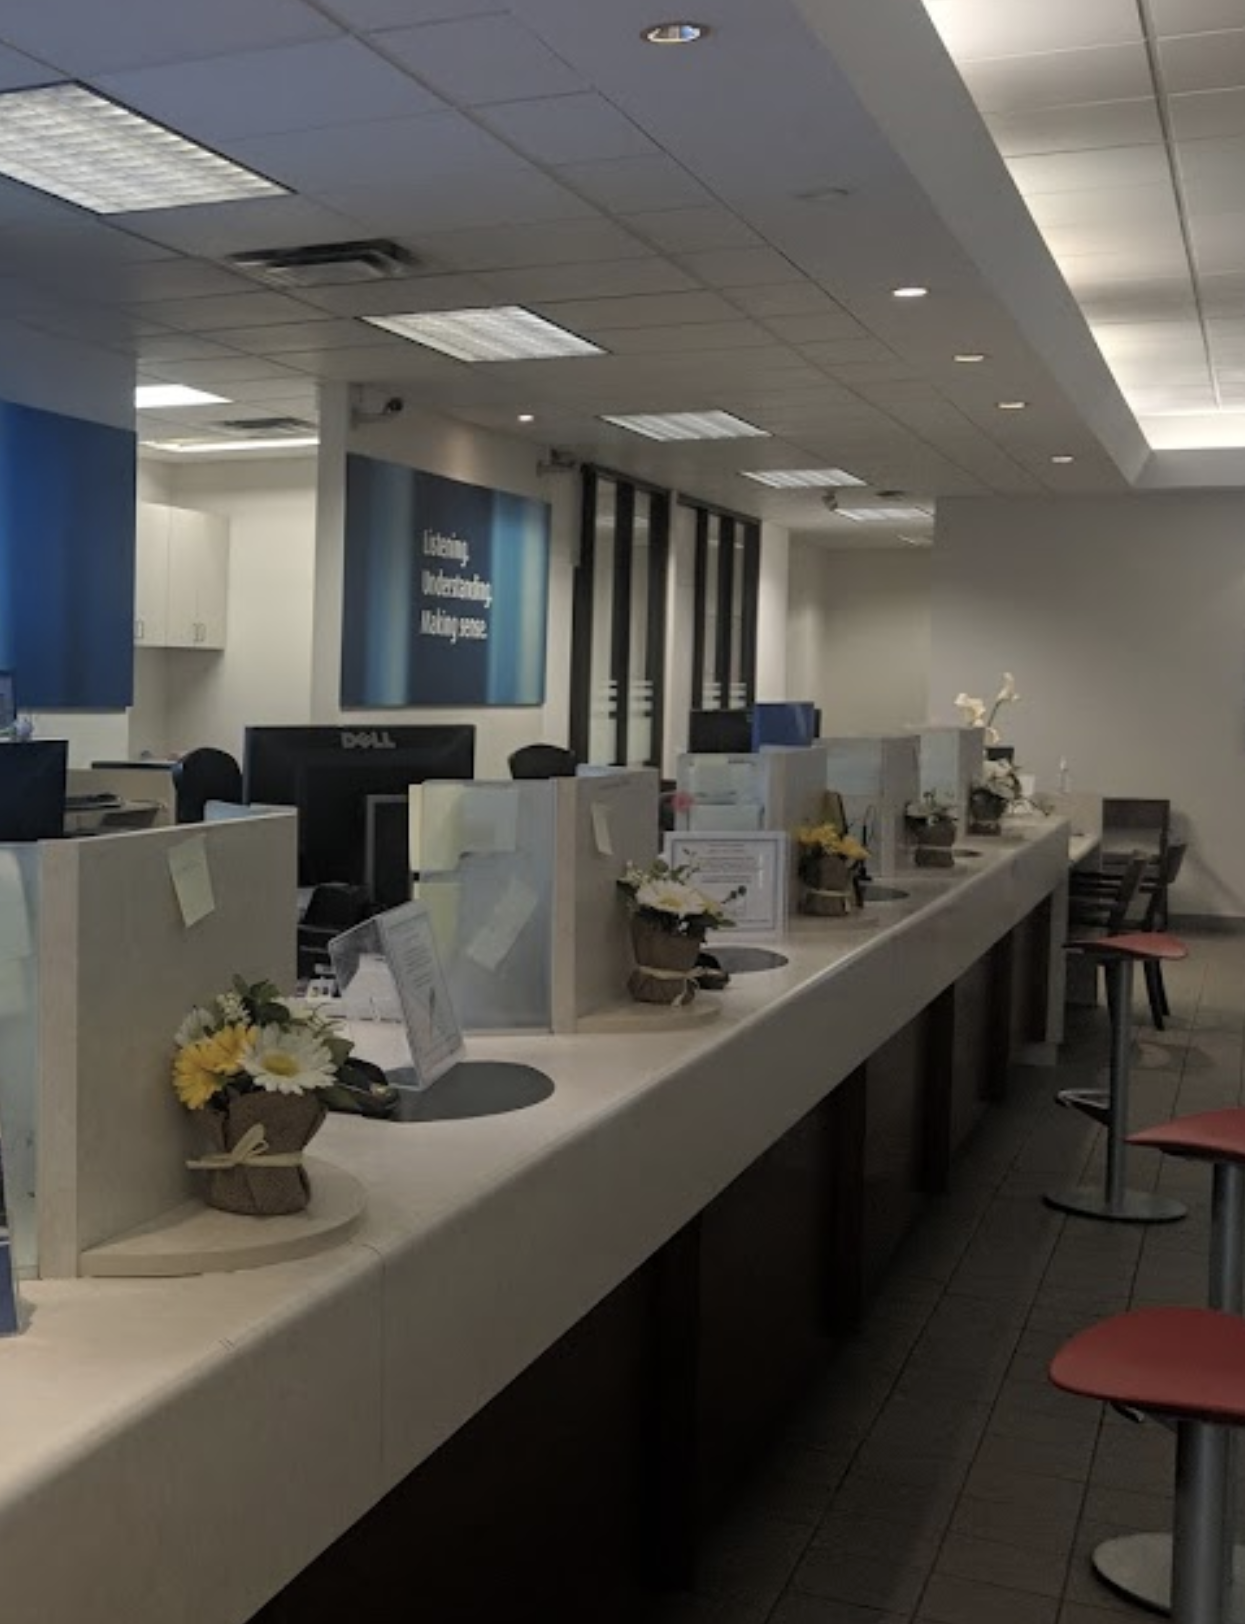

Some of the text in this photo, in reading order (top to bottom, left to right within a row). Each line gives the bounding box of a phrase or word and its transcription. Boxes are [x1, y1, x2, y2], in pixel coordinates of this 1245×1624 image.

[423, 529, 469, 568] Listening.
[421, 569, 493, 608] Understanding.
[420, 608, 488, 644] Making sense.
[340, 731, 397, 749] DELL
